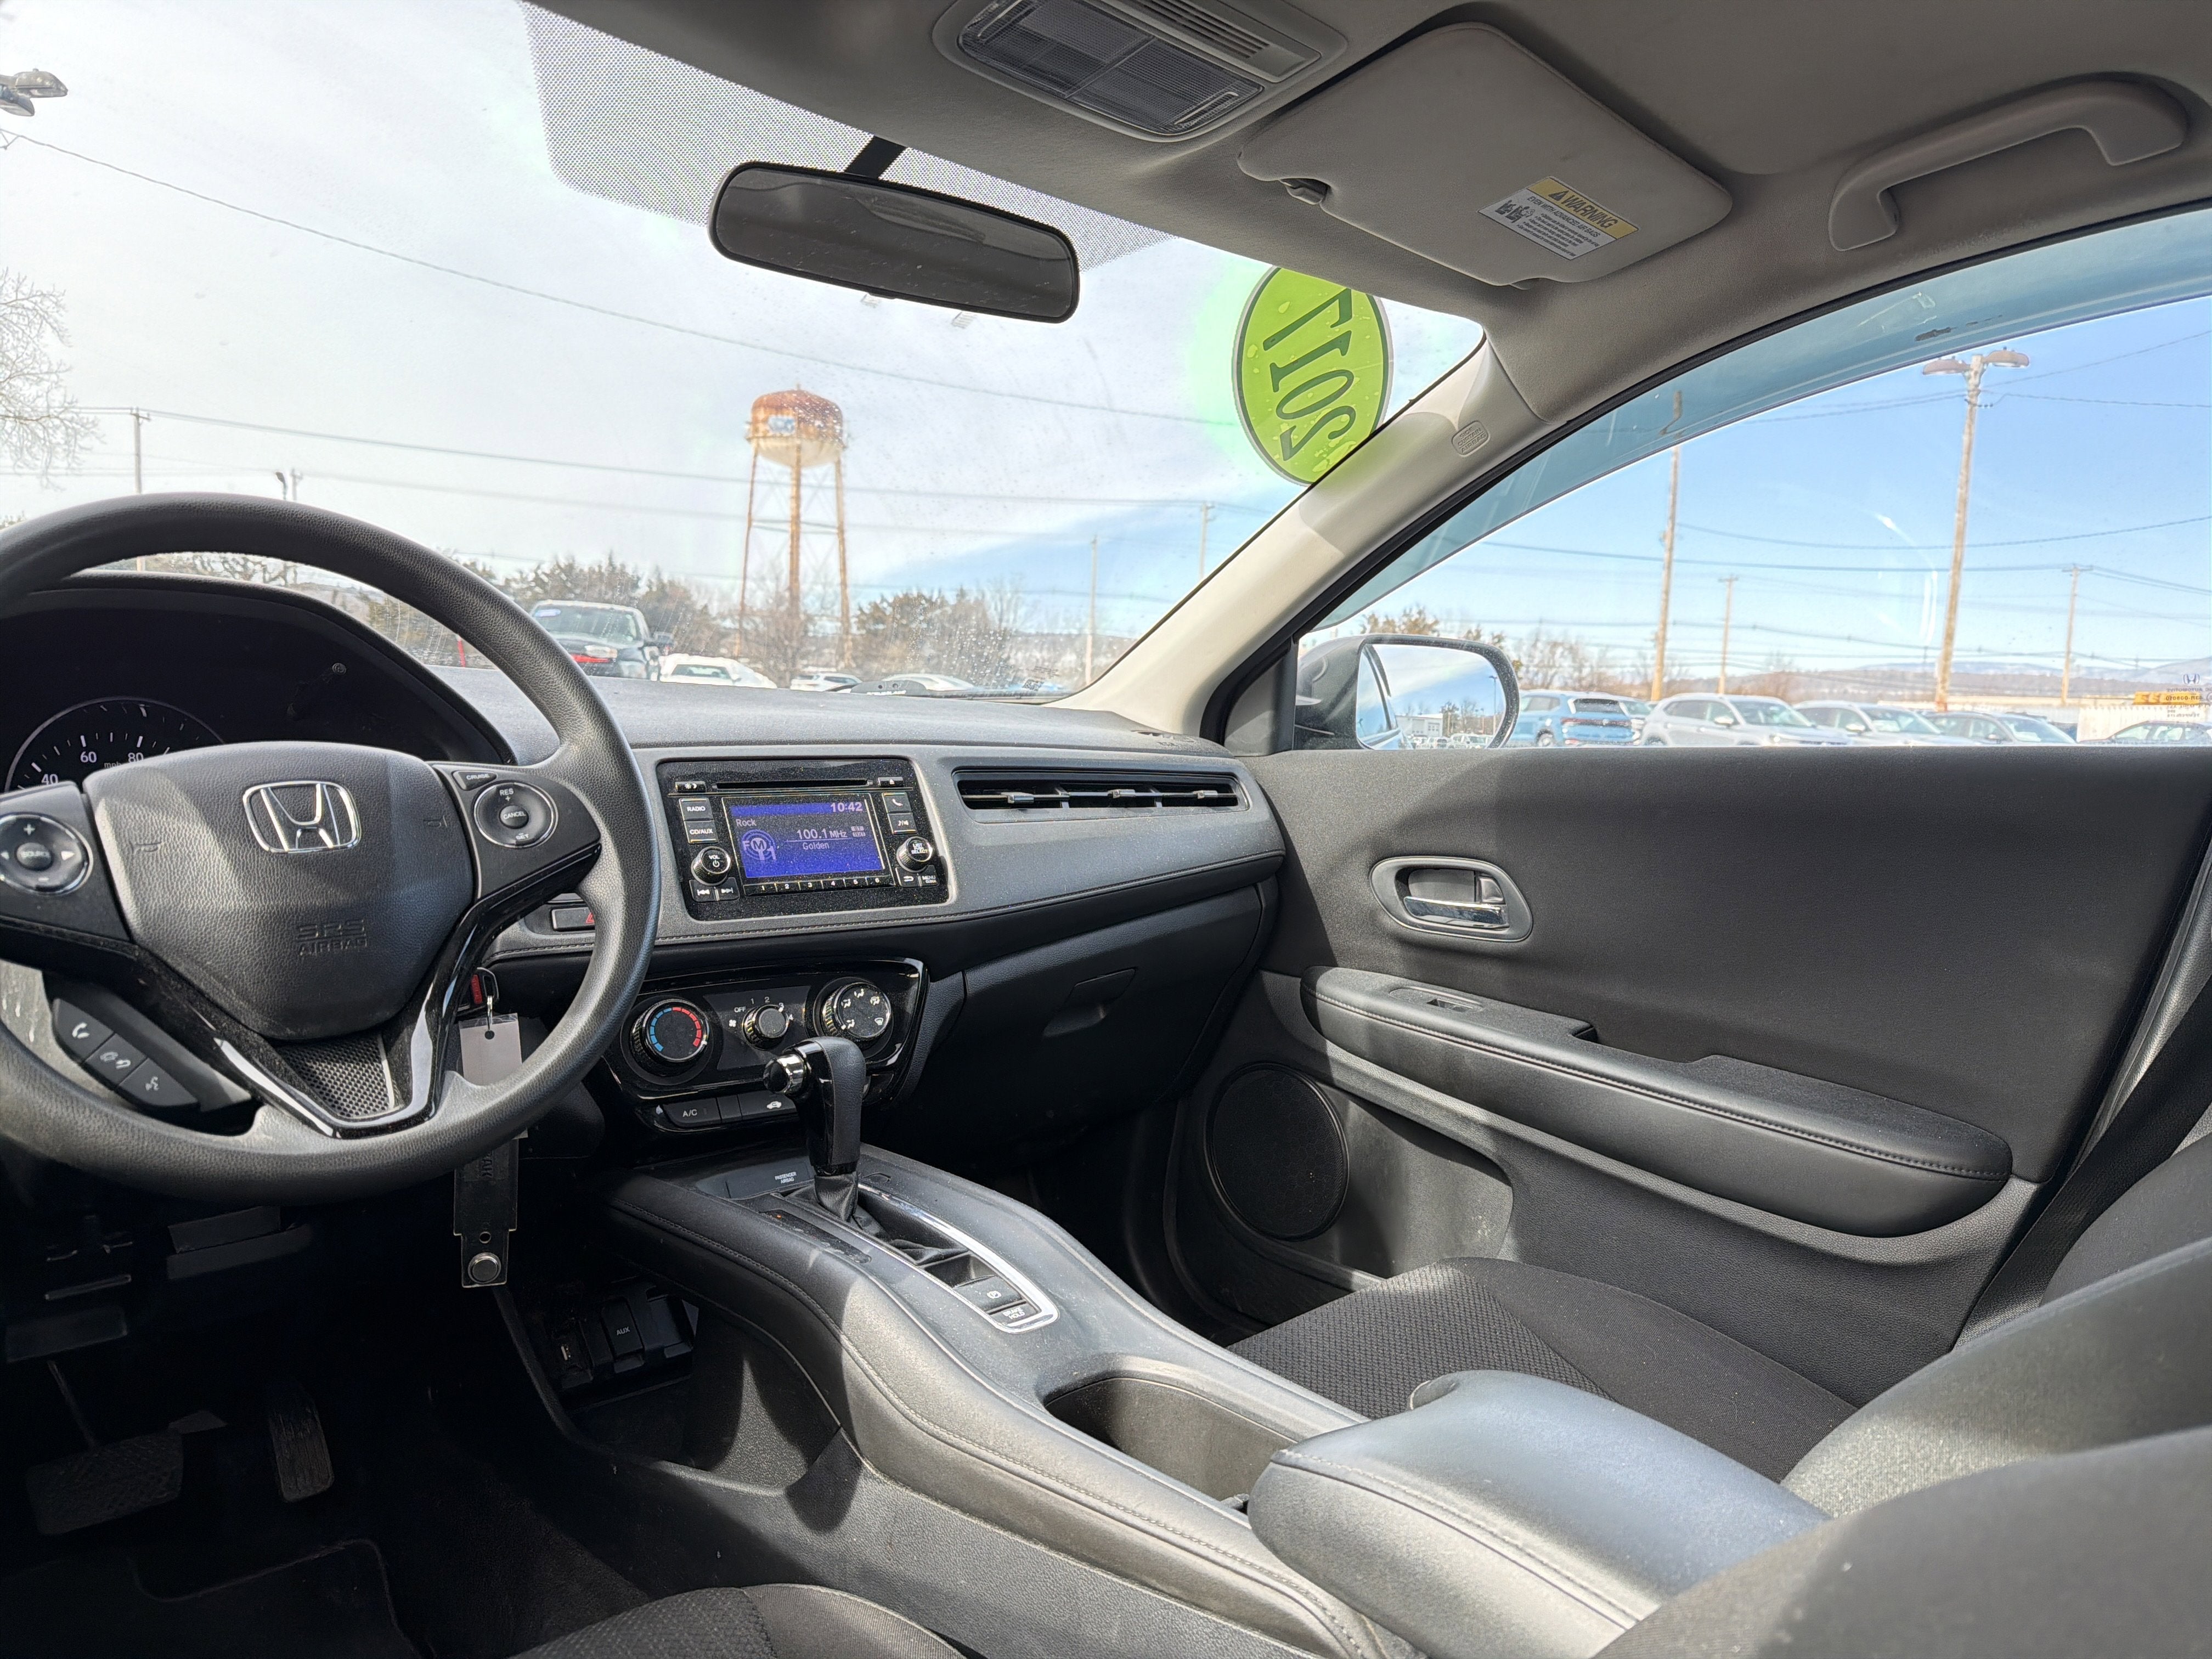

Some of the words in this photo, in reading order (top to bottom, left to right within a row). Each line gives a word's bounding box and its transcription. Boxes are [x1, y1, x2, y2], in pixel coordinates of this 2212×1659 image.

[1561, 195, 1618, 228] WARNING
[1458, 428, 1481, 446] CURTAIN
[1459, 427, 1475, 438] SIDE
[1462, 433, 1486, 453] AIRBAG
[80, 751, 97, 763] 60
[128, 752, 144, 763] 80
[41, 774, 58, 785] 40
[499, 788, 514, 796] RES
[831, 802, 863, 812] 10:42
[503, 811, 527, 820] CANCEL
[736, 819, 757, 827] Rock
[797, 828, 828, 839] 100.1
[830, 830, 848, 838] MHz
[803, 842, 830, 850] Golden
[298, 938, 368, 956] AIRBAG
[682, 1107, 698, 1118] A/C
[774, 1171, 797, 1181] PASSENGER
[1002, 1307, 1024, 1317] BRAKE
[1008, 1311, 1025, 1319] HOLD
[616, 1326, 630, 1336] AUX
